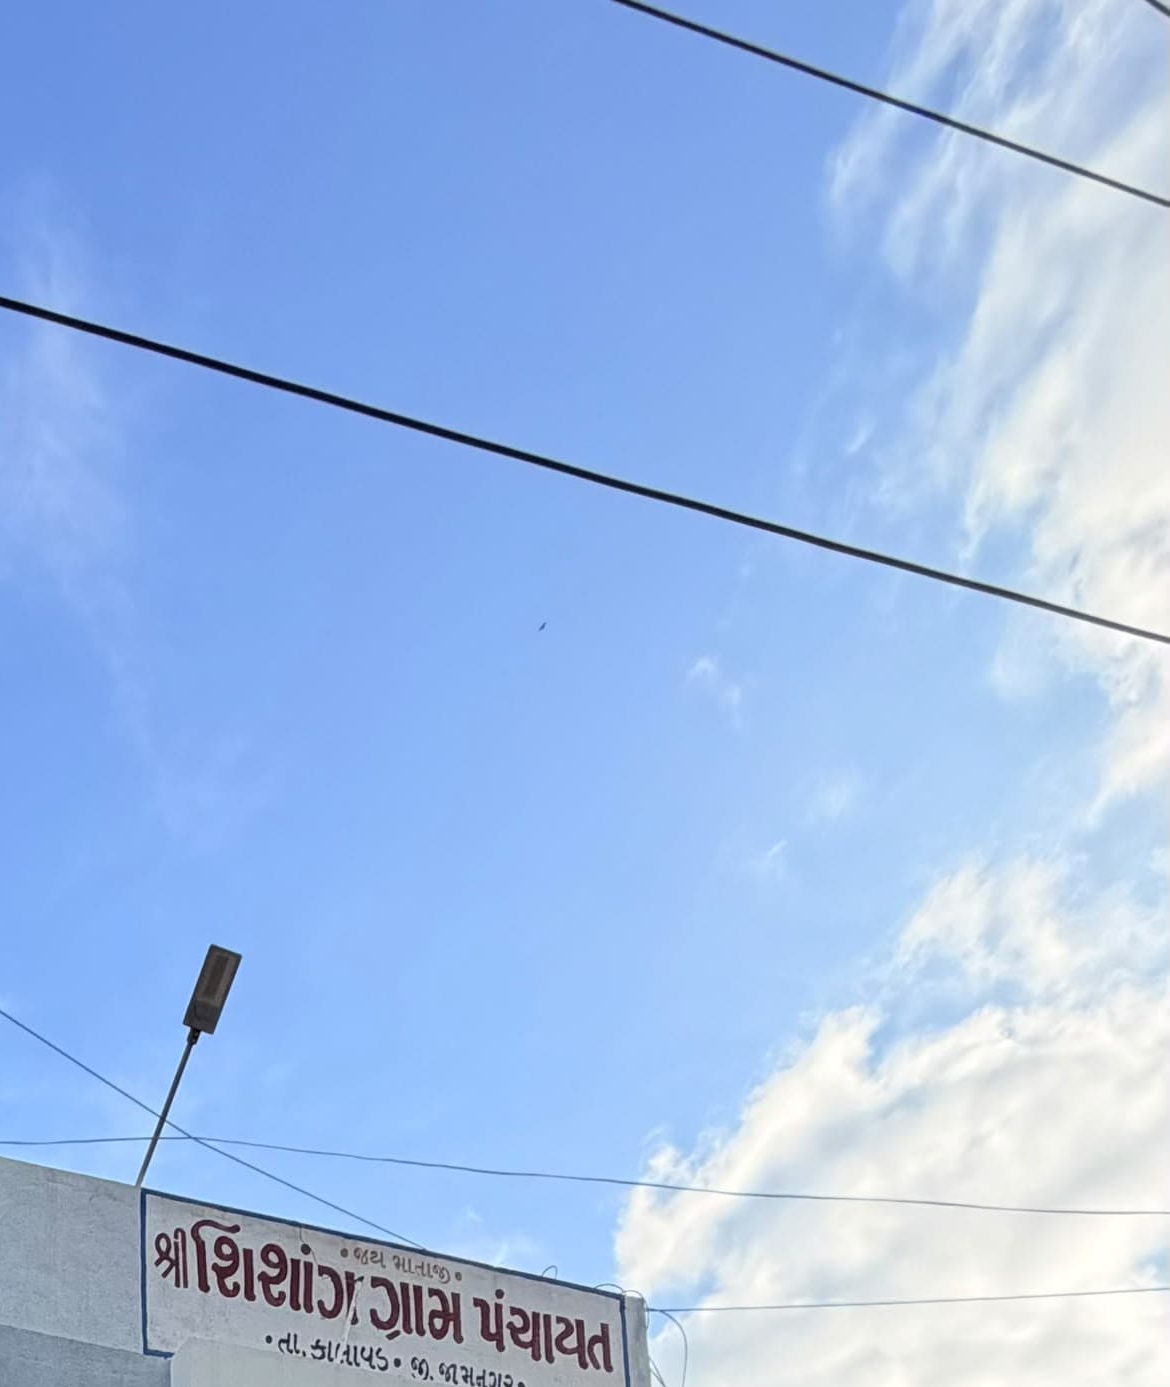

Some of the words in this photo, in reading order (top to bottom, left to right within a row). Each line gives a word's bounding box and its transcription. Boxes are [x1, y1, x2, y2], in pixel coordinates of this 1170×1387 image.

[154, 1227, 189, 1289] શ્રી
[191, 1219, 361, 1326] શિશાંગ
[370, 1275, 465, 1344] ગ્રામ
[473, 1288, 615, 1374] પંચાયત
[353, 1246, 386, 1269] જય
[392, 1254, 451, 1284] માતાજી
